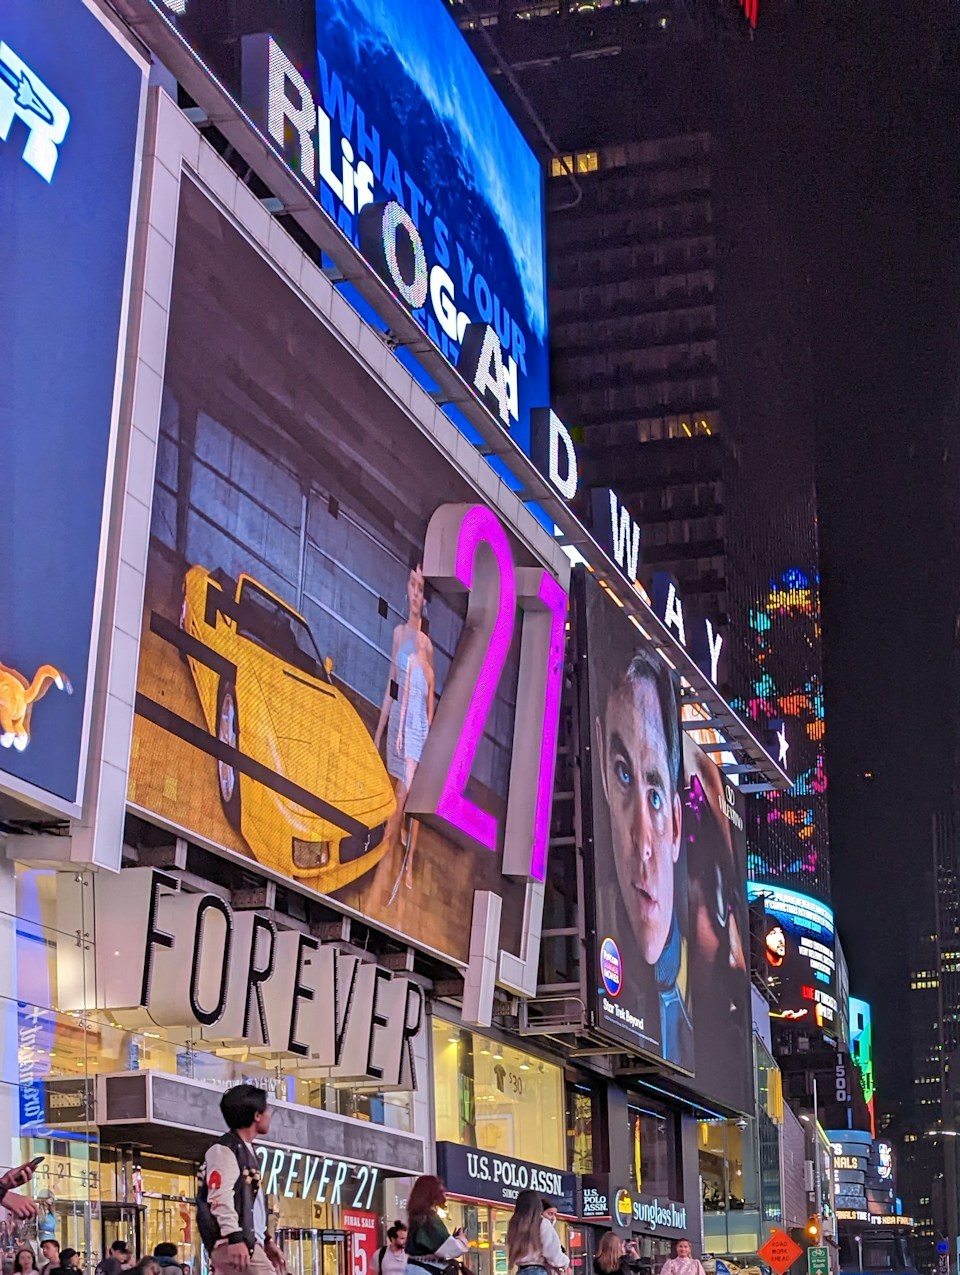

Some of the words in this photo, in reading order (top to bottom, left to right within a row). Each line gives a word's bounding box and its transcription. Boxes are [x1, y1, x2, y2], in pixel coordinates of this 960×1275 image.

[435, 505, 569, 882] 21
[139, 866, 425, 1092] FOREVER
[603, 998, 614, 1015] Star
[614, 1003, 625, 1019] Trek
[625, 1009, 644, 1030] Beyond
[836, 1053, 847, 1102] 1500
[352, 1166, 379, 1210] 21
[467, 1153, 491, 1181] U.S.
[493, 1159, 528, 1189] POLO
[530, 1168, 565, 1197] ASSN.
[584, 1188, 599, 1196] U.S.
[584, 1196, 607, 1204] POLO
[632, 1199, 672, 1230] sunglass
[672, 1203, 687, 1229] hut
[344, 1215, 361, 1228] FINAL
[361, 1217, 375, 1229] SALE
